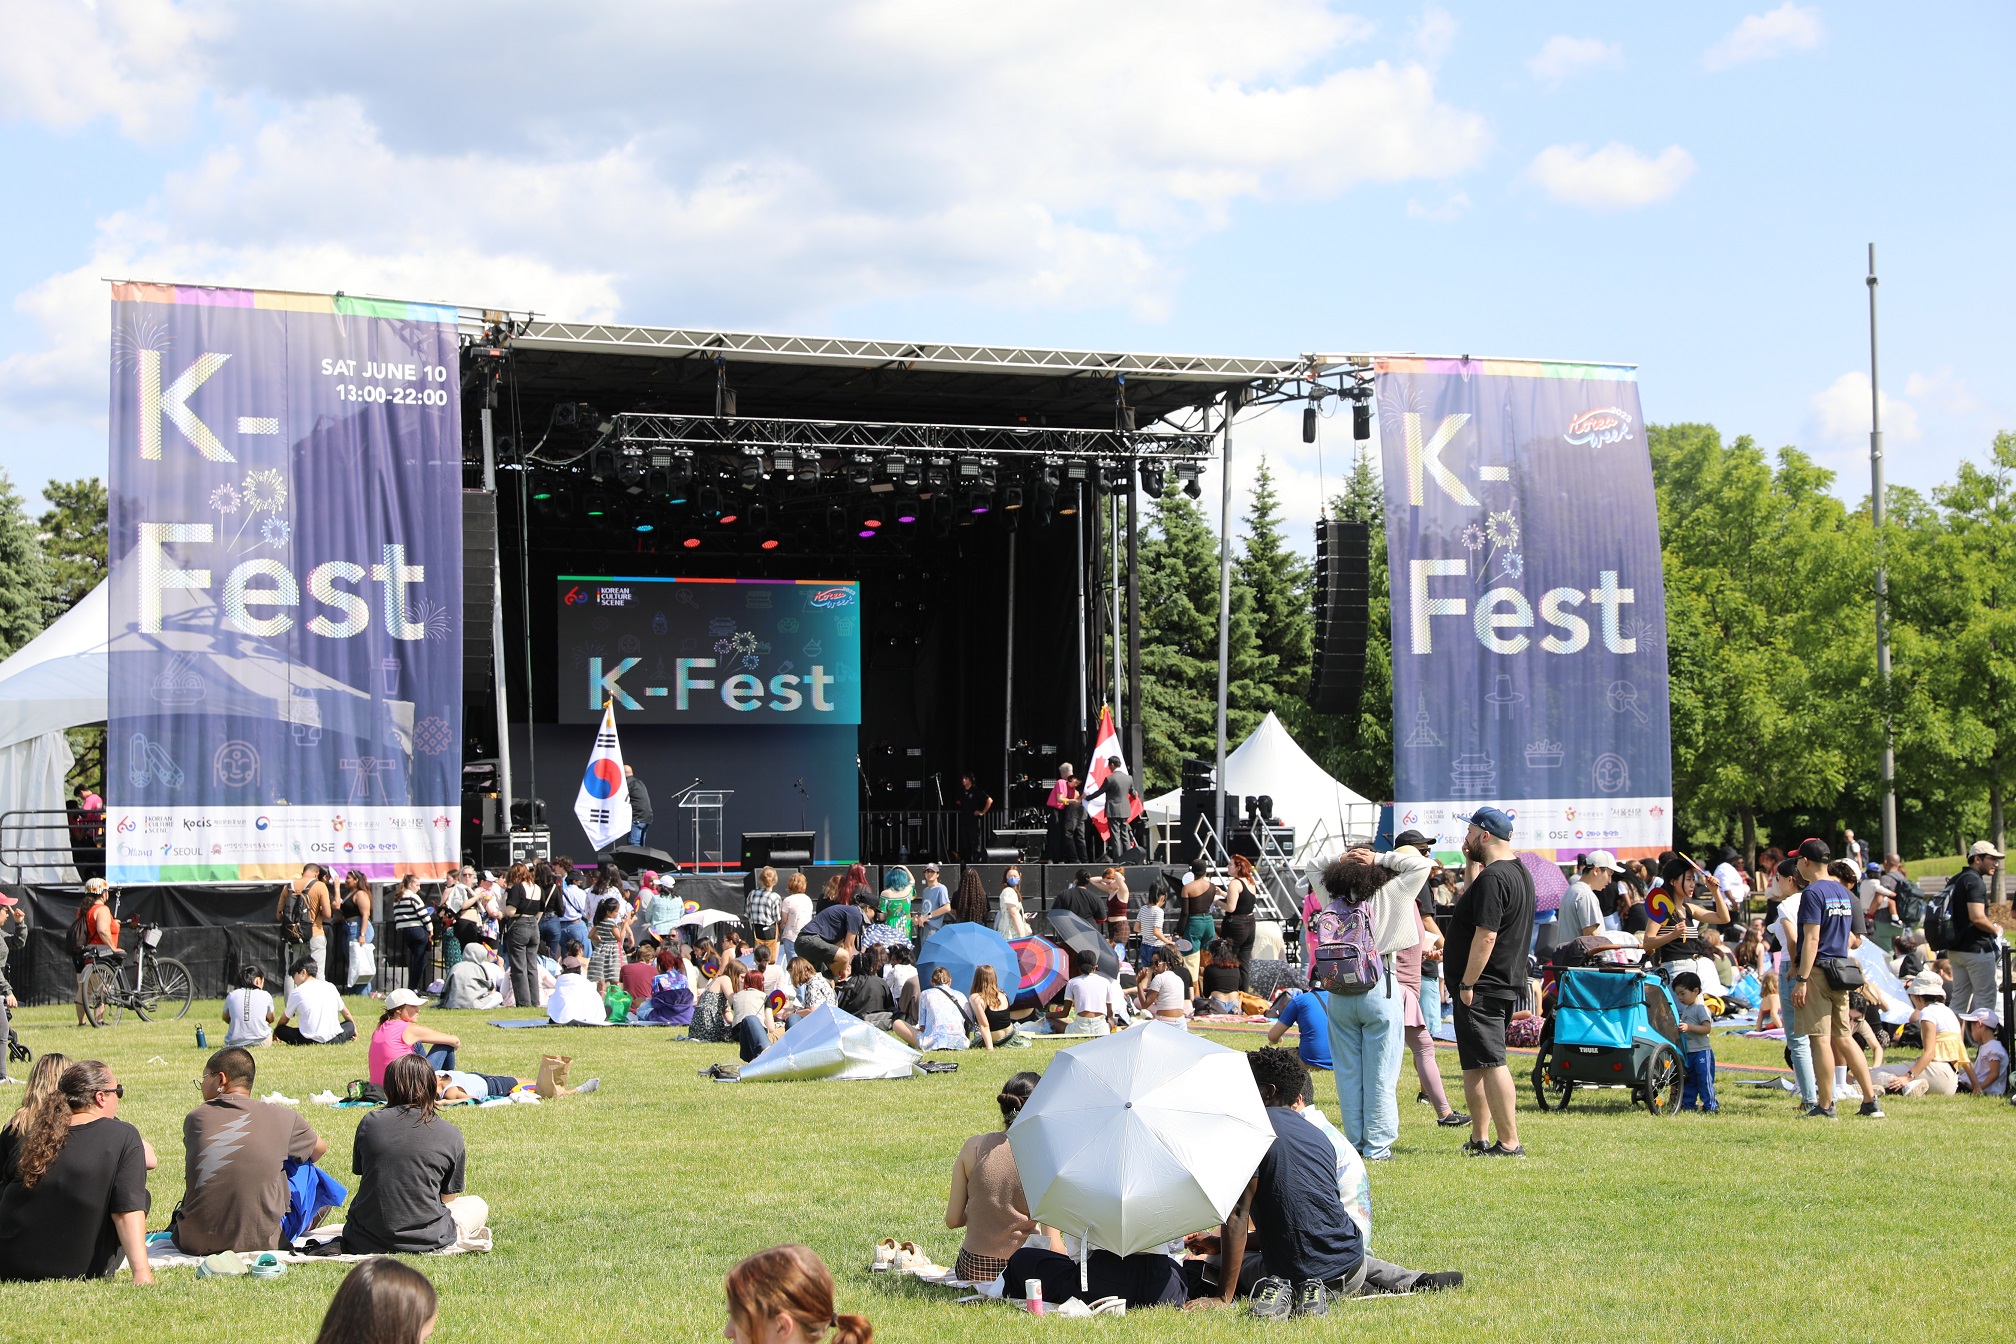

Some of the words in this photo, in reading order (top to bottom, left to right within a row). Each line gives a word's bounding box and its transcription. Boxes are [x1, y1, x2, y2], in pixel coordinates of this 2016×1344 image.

[321, 358, 357, 377] SAT
[362, 360, 417, 381] JUNE
[423, 364, 447, 383] 10
[137, 348, 280, 464] K-
[335, 384, 448, 406] 13:00-22:00
[1568, 413, 1619, 435] Korea
[1610, 406, 1633, 423] 2023
[1403, 411, 1510, 507] K-
[137, 521, 425, 640] Fest
[814, 591, 847, 602] Korea
[1409, 558, 1638, 655] Fest
[588, 656, 835, 713] K-Fest
[391, 818, 424, 828] 서울신문
[1548, 830, 1568, 839] OSE
[173, 847, 203, 856] SEOUL
[310, 842, 335, 852] OSE
[1578, 1046, 1599, 1054] THULE
